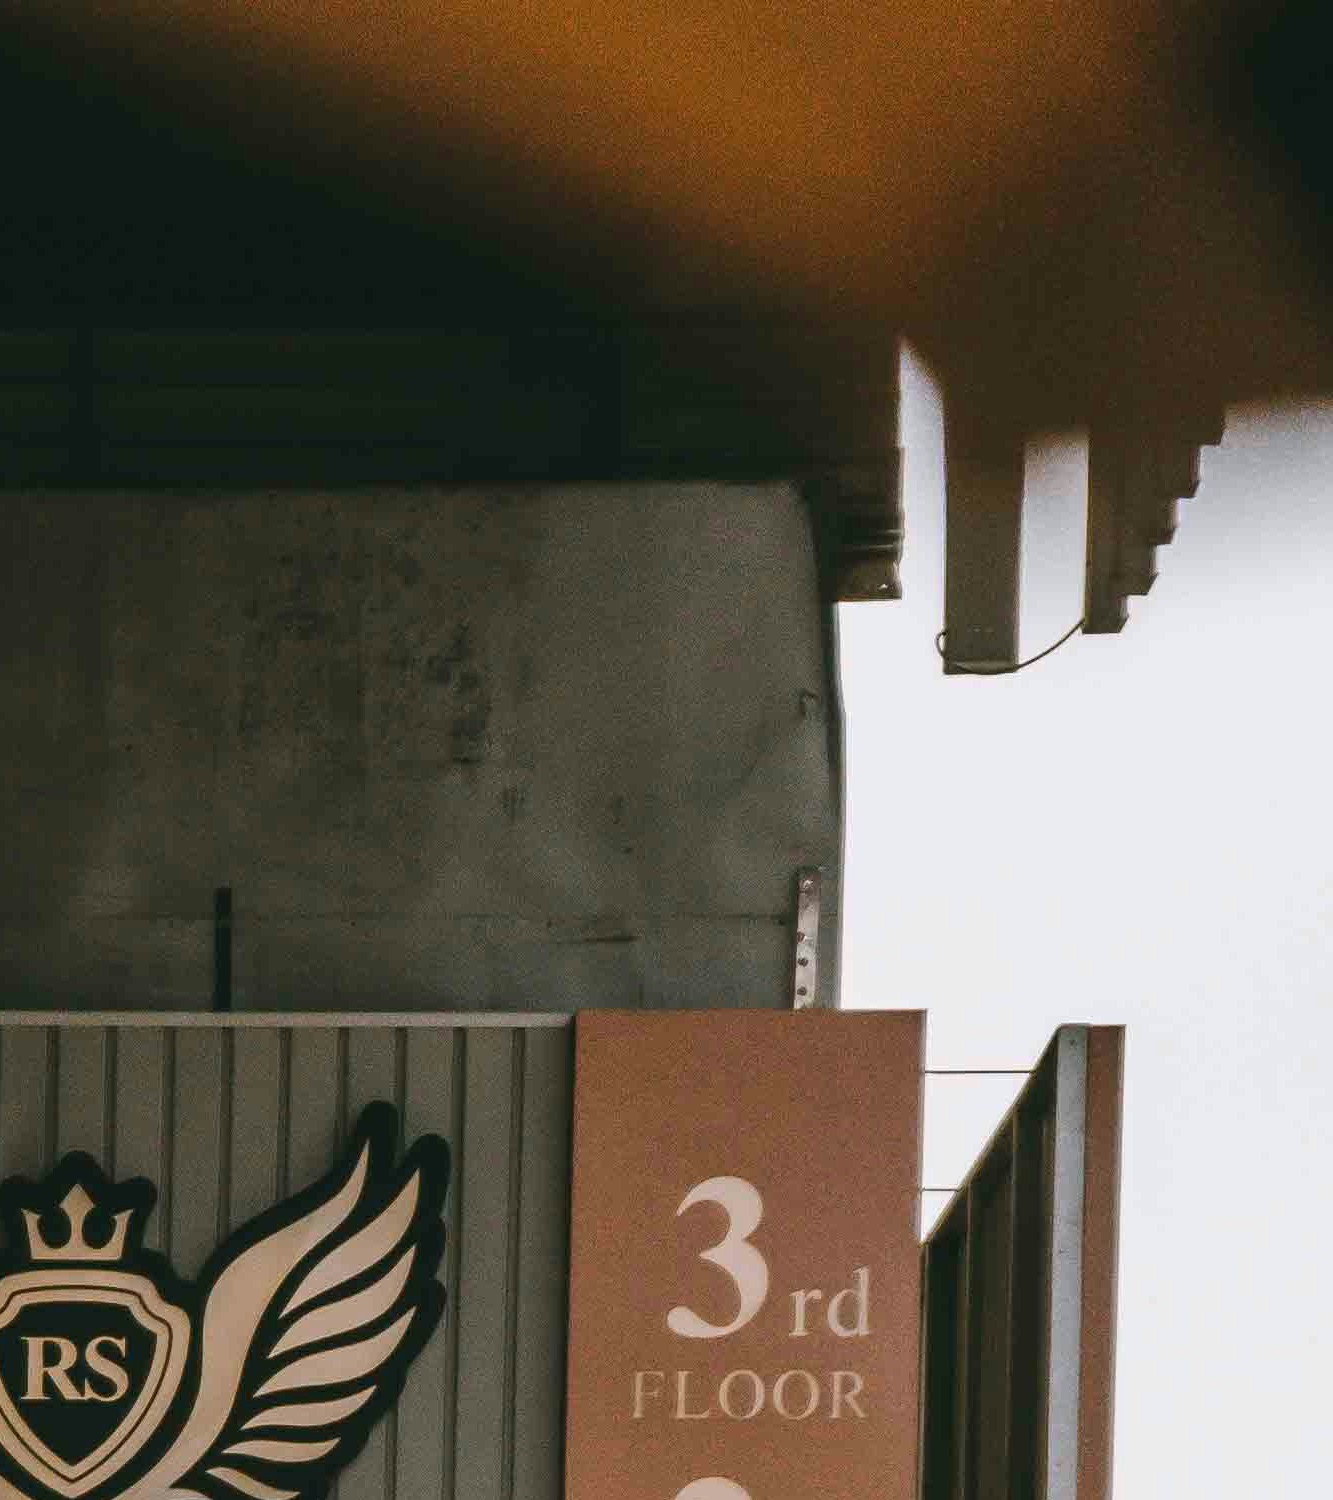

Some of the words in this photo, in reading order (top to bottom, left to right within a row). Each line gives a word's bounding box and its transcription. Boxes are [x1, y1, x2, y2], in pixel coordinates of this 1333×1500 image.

[666, 1175, 871, 1340] 3rd
[21, 1336, 129, 1403] RS
[632, 1369, 868, 1420] FLOOR
